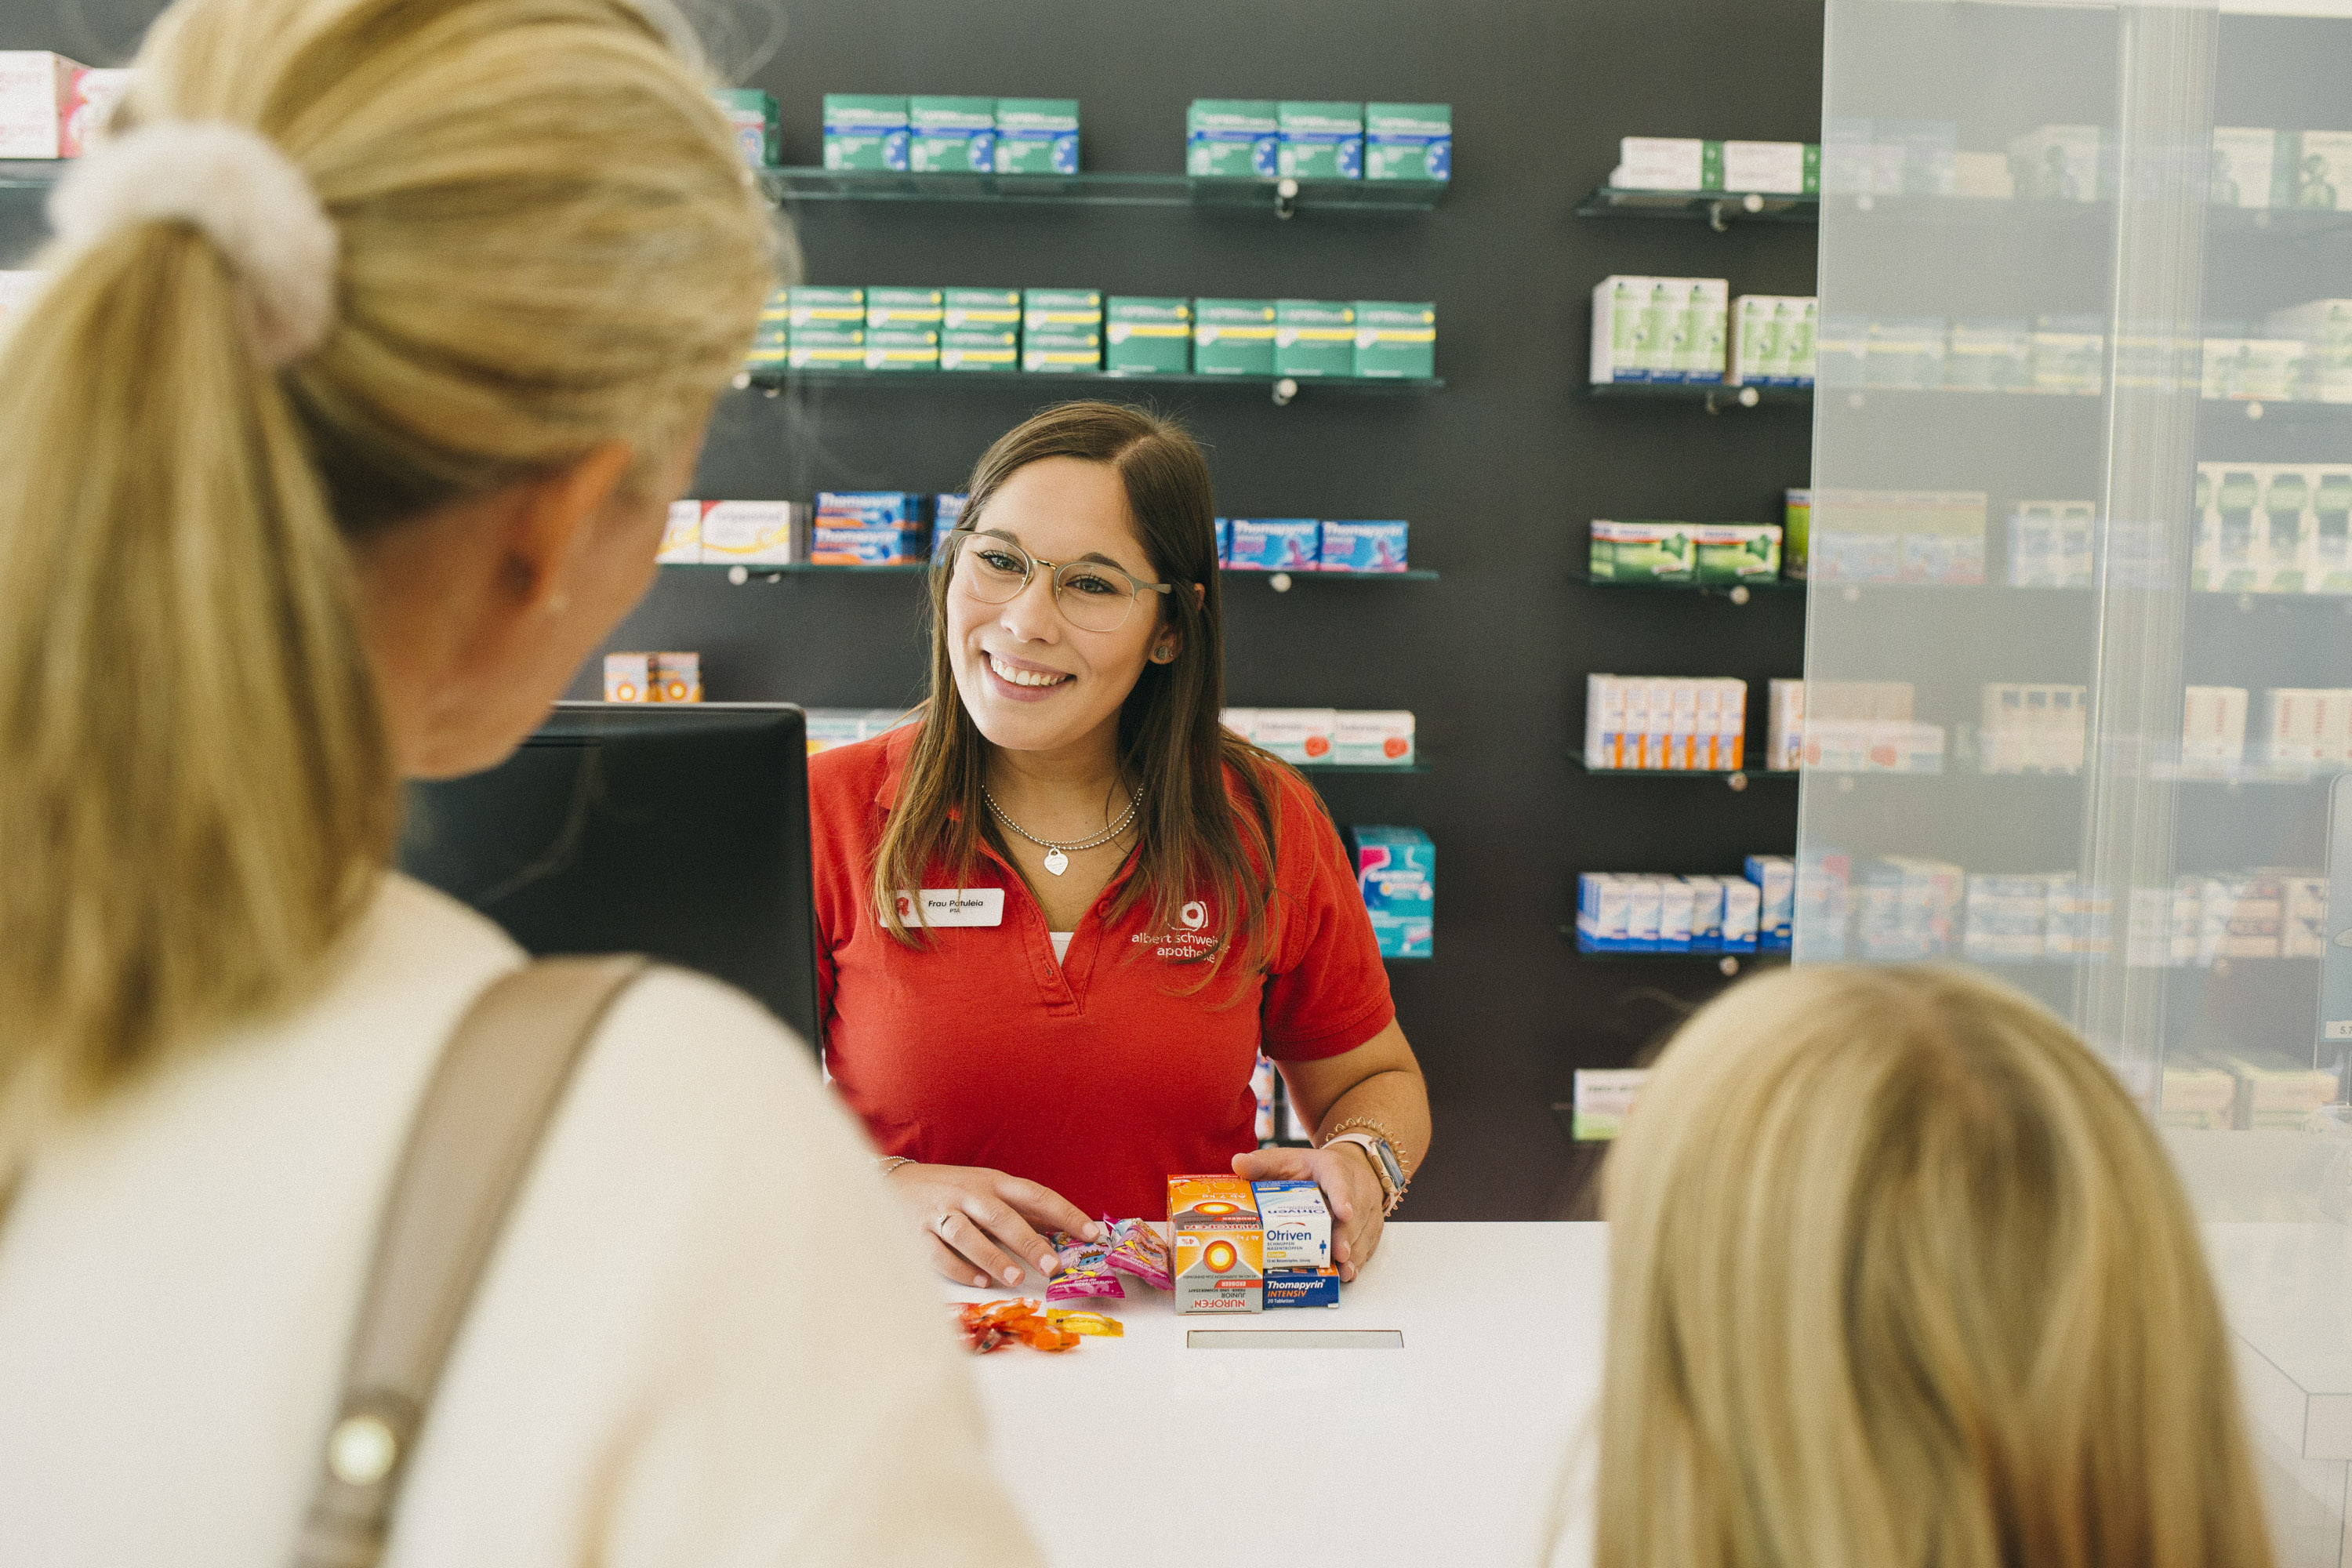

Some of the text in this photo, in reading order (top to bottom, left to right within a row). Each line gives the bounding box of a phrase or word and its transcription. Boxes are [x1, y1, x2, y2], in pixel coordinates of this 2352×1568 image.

[1131, 932, 1172, 944] albert
[1267, 1230, 1312, 1241] Otriven
[1267, 1279, 1323, 1290] Thomapyrin
[1194, 1299, 1246, 1308] NUROFEN
